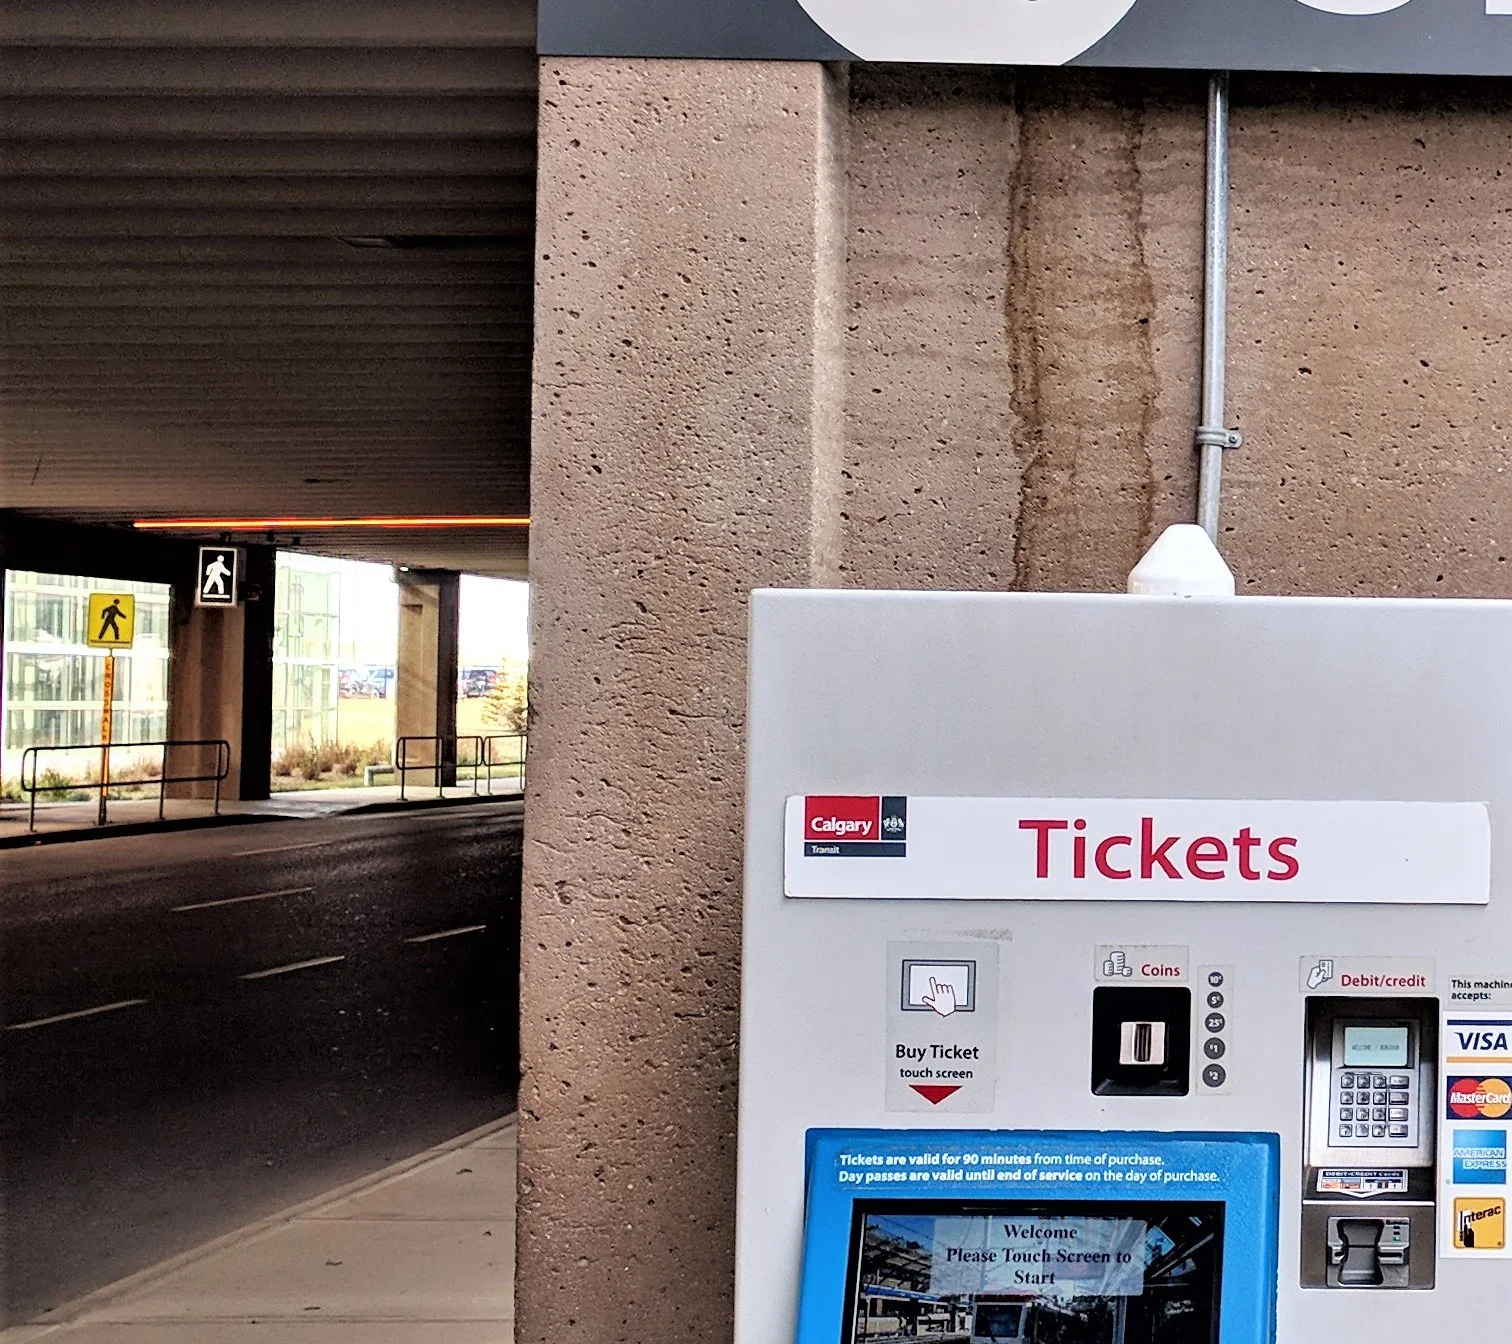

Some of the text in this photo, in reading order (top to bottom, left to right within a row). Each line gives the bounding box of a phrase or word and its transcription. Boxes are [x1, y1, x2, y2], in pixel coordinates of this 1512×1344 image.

[810, 816, 873, 836] Calgary
[811, 844, 840, 855] Transit
[1018, 816, 1300, 881] Tickets
[1141, 964, 1181, 977] Coins
[1340, 973, 1427, 988] Debit/credit
[1451, 979, 1472, 989] This
[1451, 991, 1492, 1002] accepts:
[1454, 1031, 1509, 1051] VISA
[895, 1043, 980, 1063] Buy Ticket
[899, 1066, 974, 1079] touch screen
[1449, 1091, 1512, 1105] MasterCard
[839, 1153, 1165, 1168] Tickets are valid for 90 minutes from time of purchase.
[1453, 1148, 1505, 1158] AMERICAN
[1463, 1159, 1508, 1169] EXPRESS
[838, 1169, 1221, 1184] Day passes are valid until end of service on the day of purchase.
[1003, 1223, 1078, 1239] Welcome
[945, 1247, 1133, 1264] Please Touch Screen to
[1013, 1269, 1056, 1285] Start
